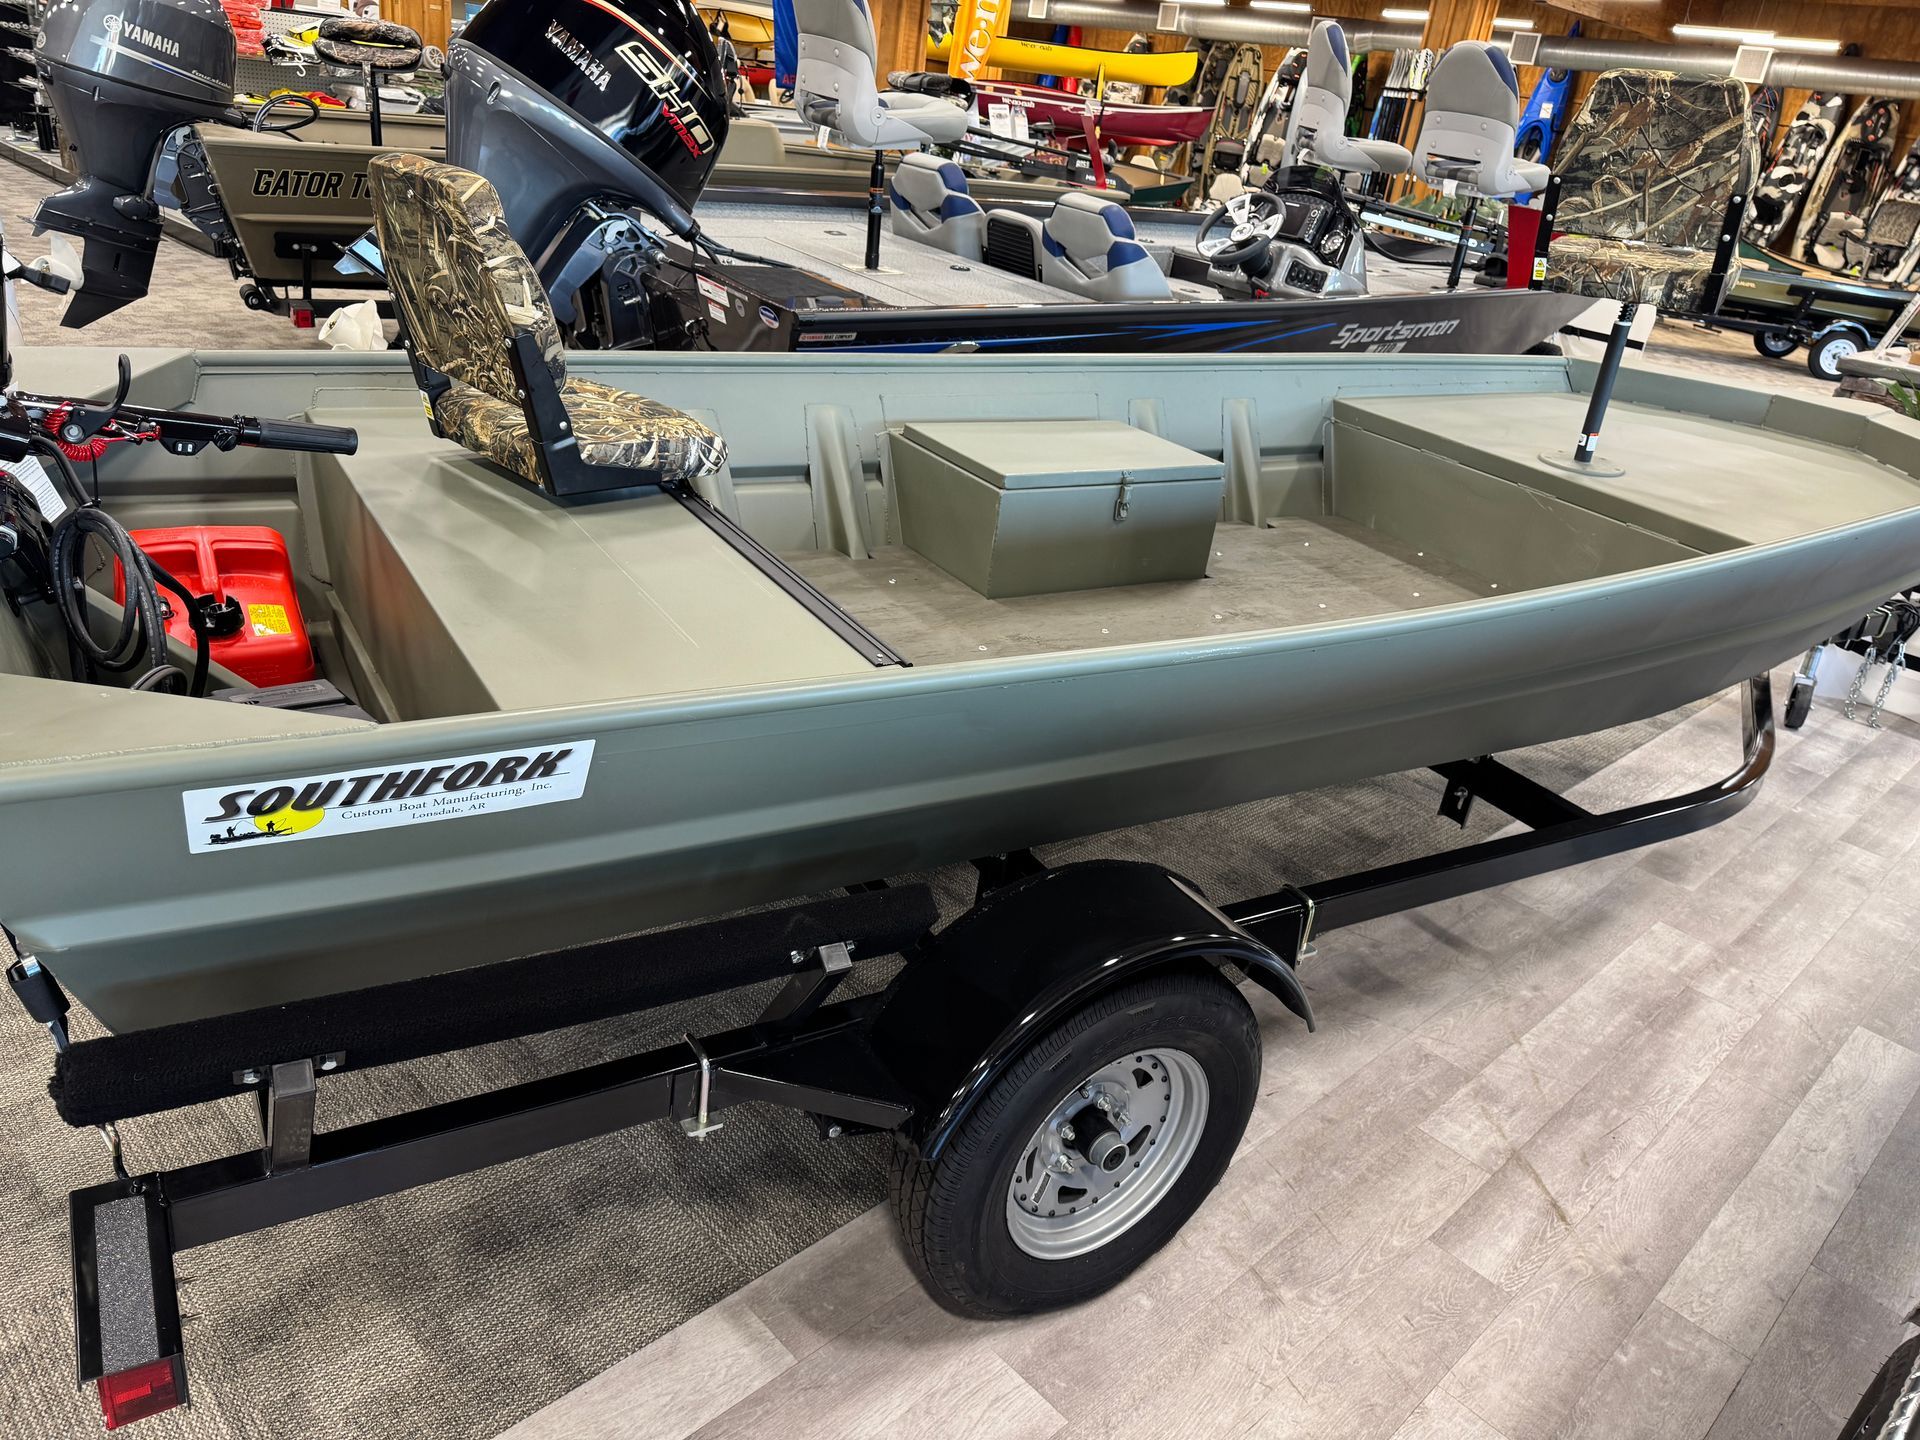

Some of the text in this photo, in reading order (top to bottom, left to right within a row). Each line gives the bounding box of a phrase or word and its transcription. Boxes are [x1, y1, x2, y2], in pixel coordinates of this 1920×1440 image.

[124, 21, 179, 58] YAMAHA
[545, 19, 612, 92] YAMAHA
[614, 41, 715, 153] SHO
[252, 168, 346, 199] GATOR
[1329, 319, 1461, 349] Sportsman
[203, 749, 574, 822] SOUTHFORK
[341, 781, 553, 820] Custom Boat Manufacturing, Inc.
[412, 802, 486, 820] Lonsdale, AR
